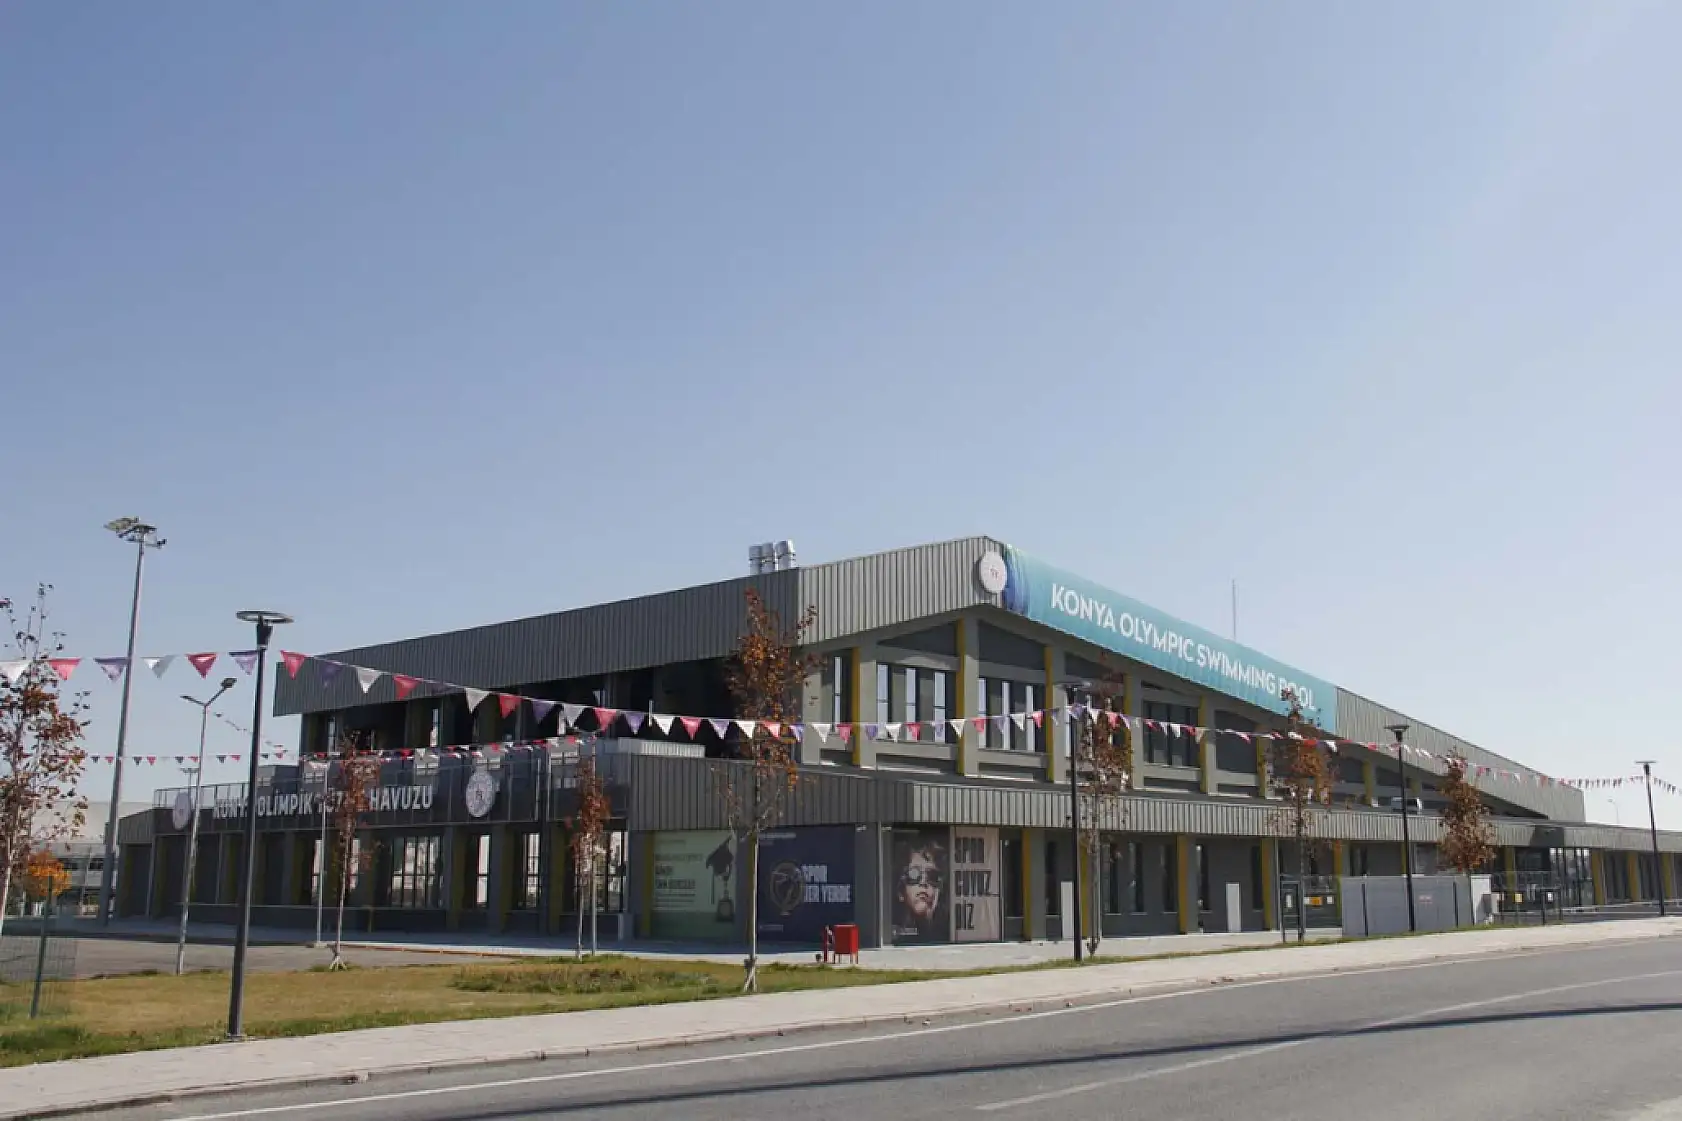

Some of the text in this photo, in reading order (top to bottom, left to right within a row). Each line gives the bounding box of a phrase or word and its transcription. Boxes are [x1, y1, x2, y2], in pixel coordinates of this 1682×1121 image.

[1052, 583, 1115, 633] KONYA
[1119, 612, 1194, 663] OLYMPIC
[1197, 644, 1276, 693] SWIMMING
[213, 796, 249, 819] KONY
[257, 788, 313, 817] OLİMPİK
[369, 784, 433, 812] HAVUZU
